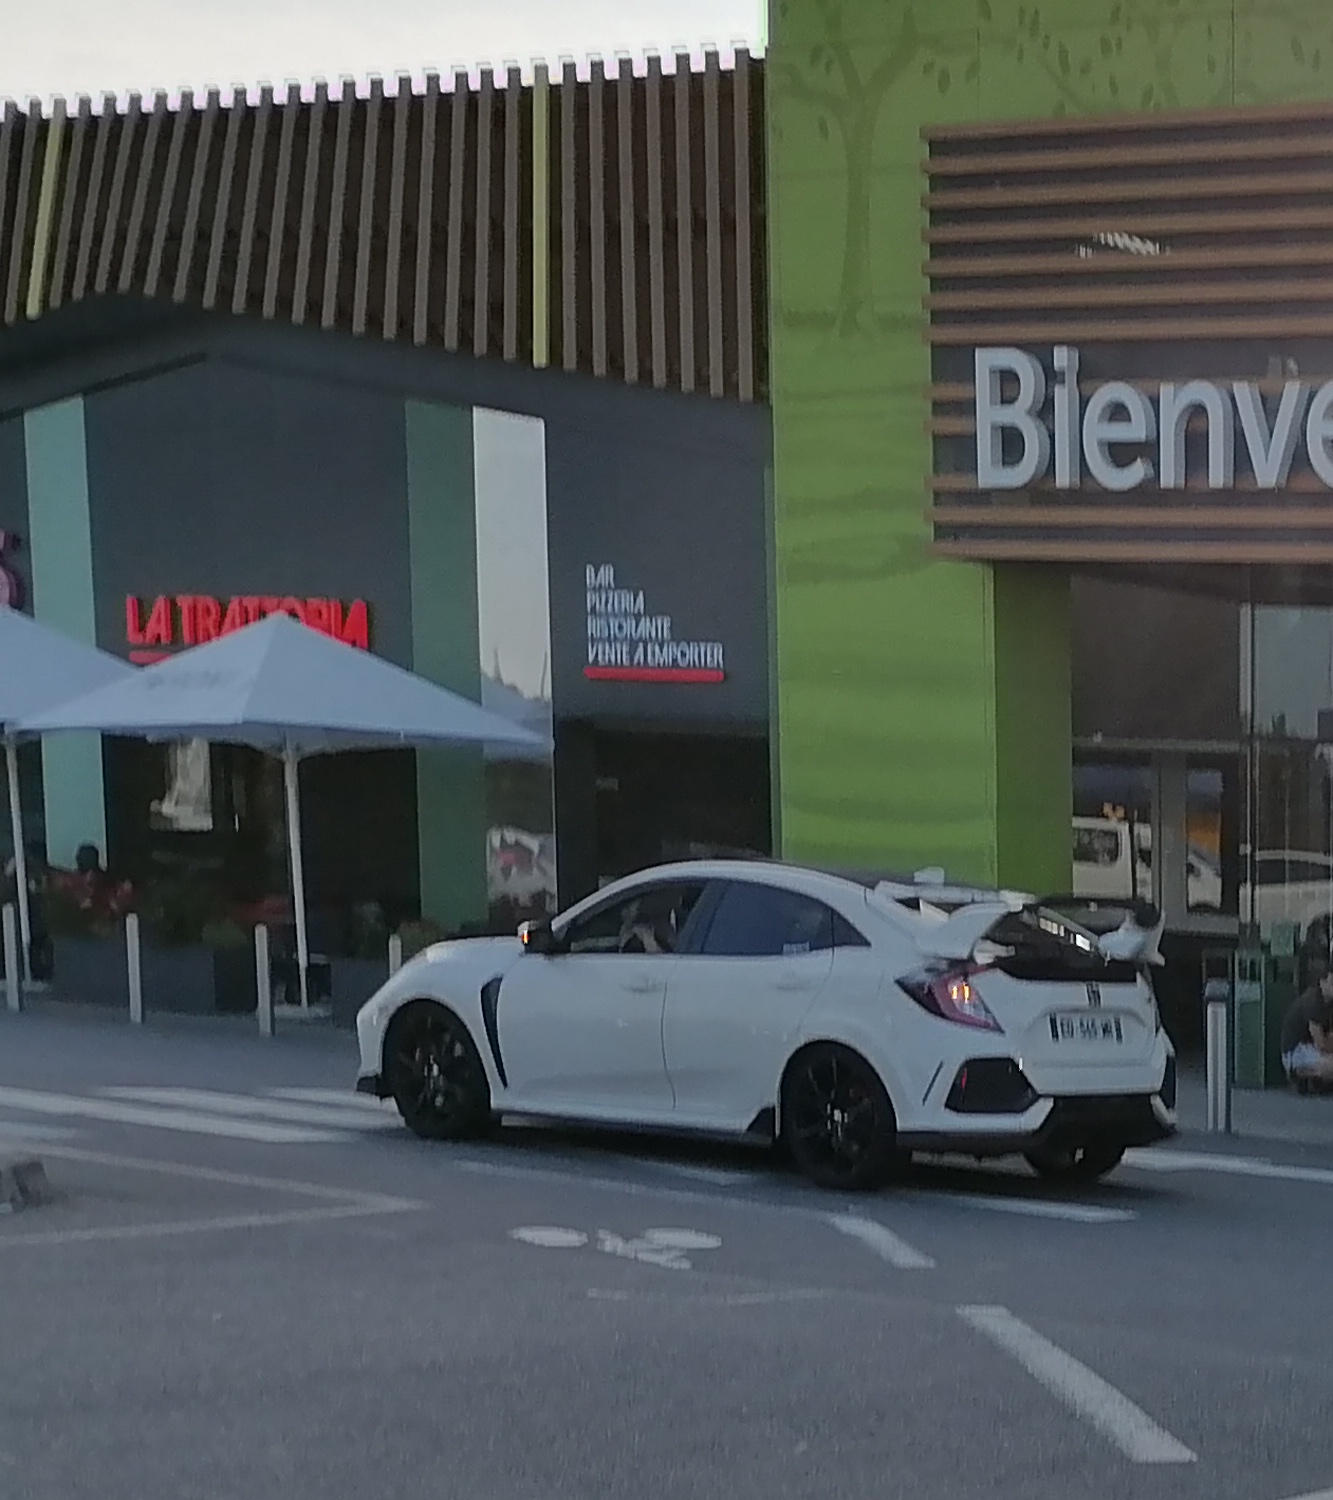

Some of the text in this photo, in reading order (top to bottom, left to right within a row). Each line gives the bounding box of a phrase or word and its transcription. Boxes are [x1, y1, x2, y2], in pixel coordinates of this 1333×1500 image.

[586, 563, 614, 588] BAR
[586, 588, 645, 615] PIZZERIA
[126, 593, 172, 645] LA
[587, 613, 671, 643] RISTORANTE
[588, 640, 631, 667] VENTE
[647, 641, 724, 669] EMPORTER
